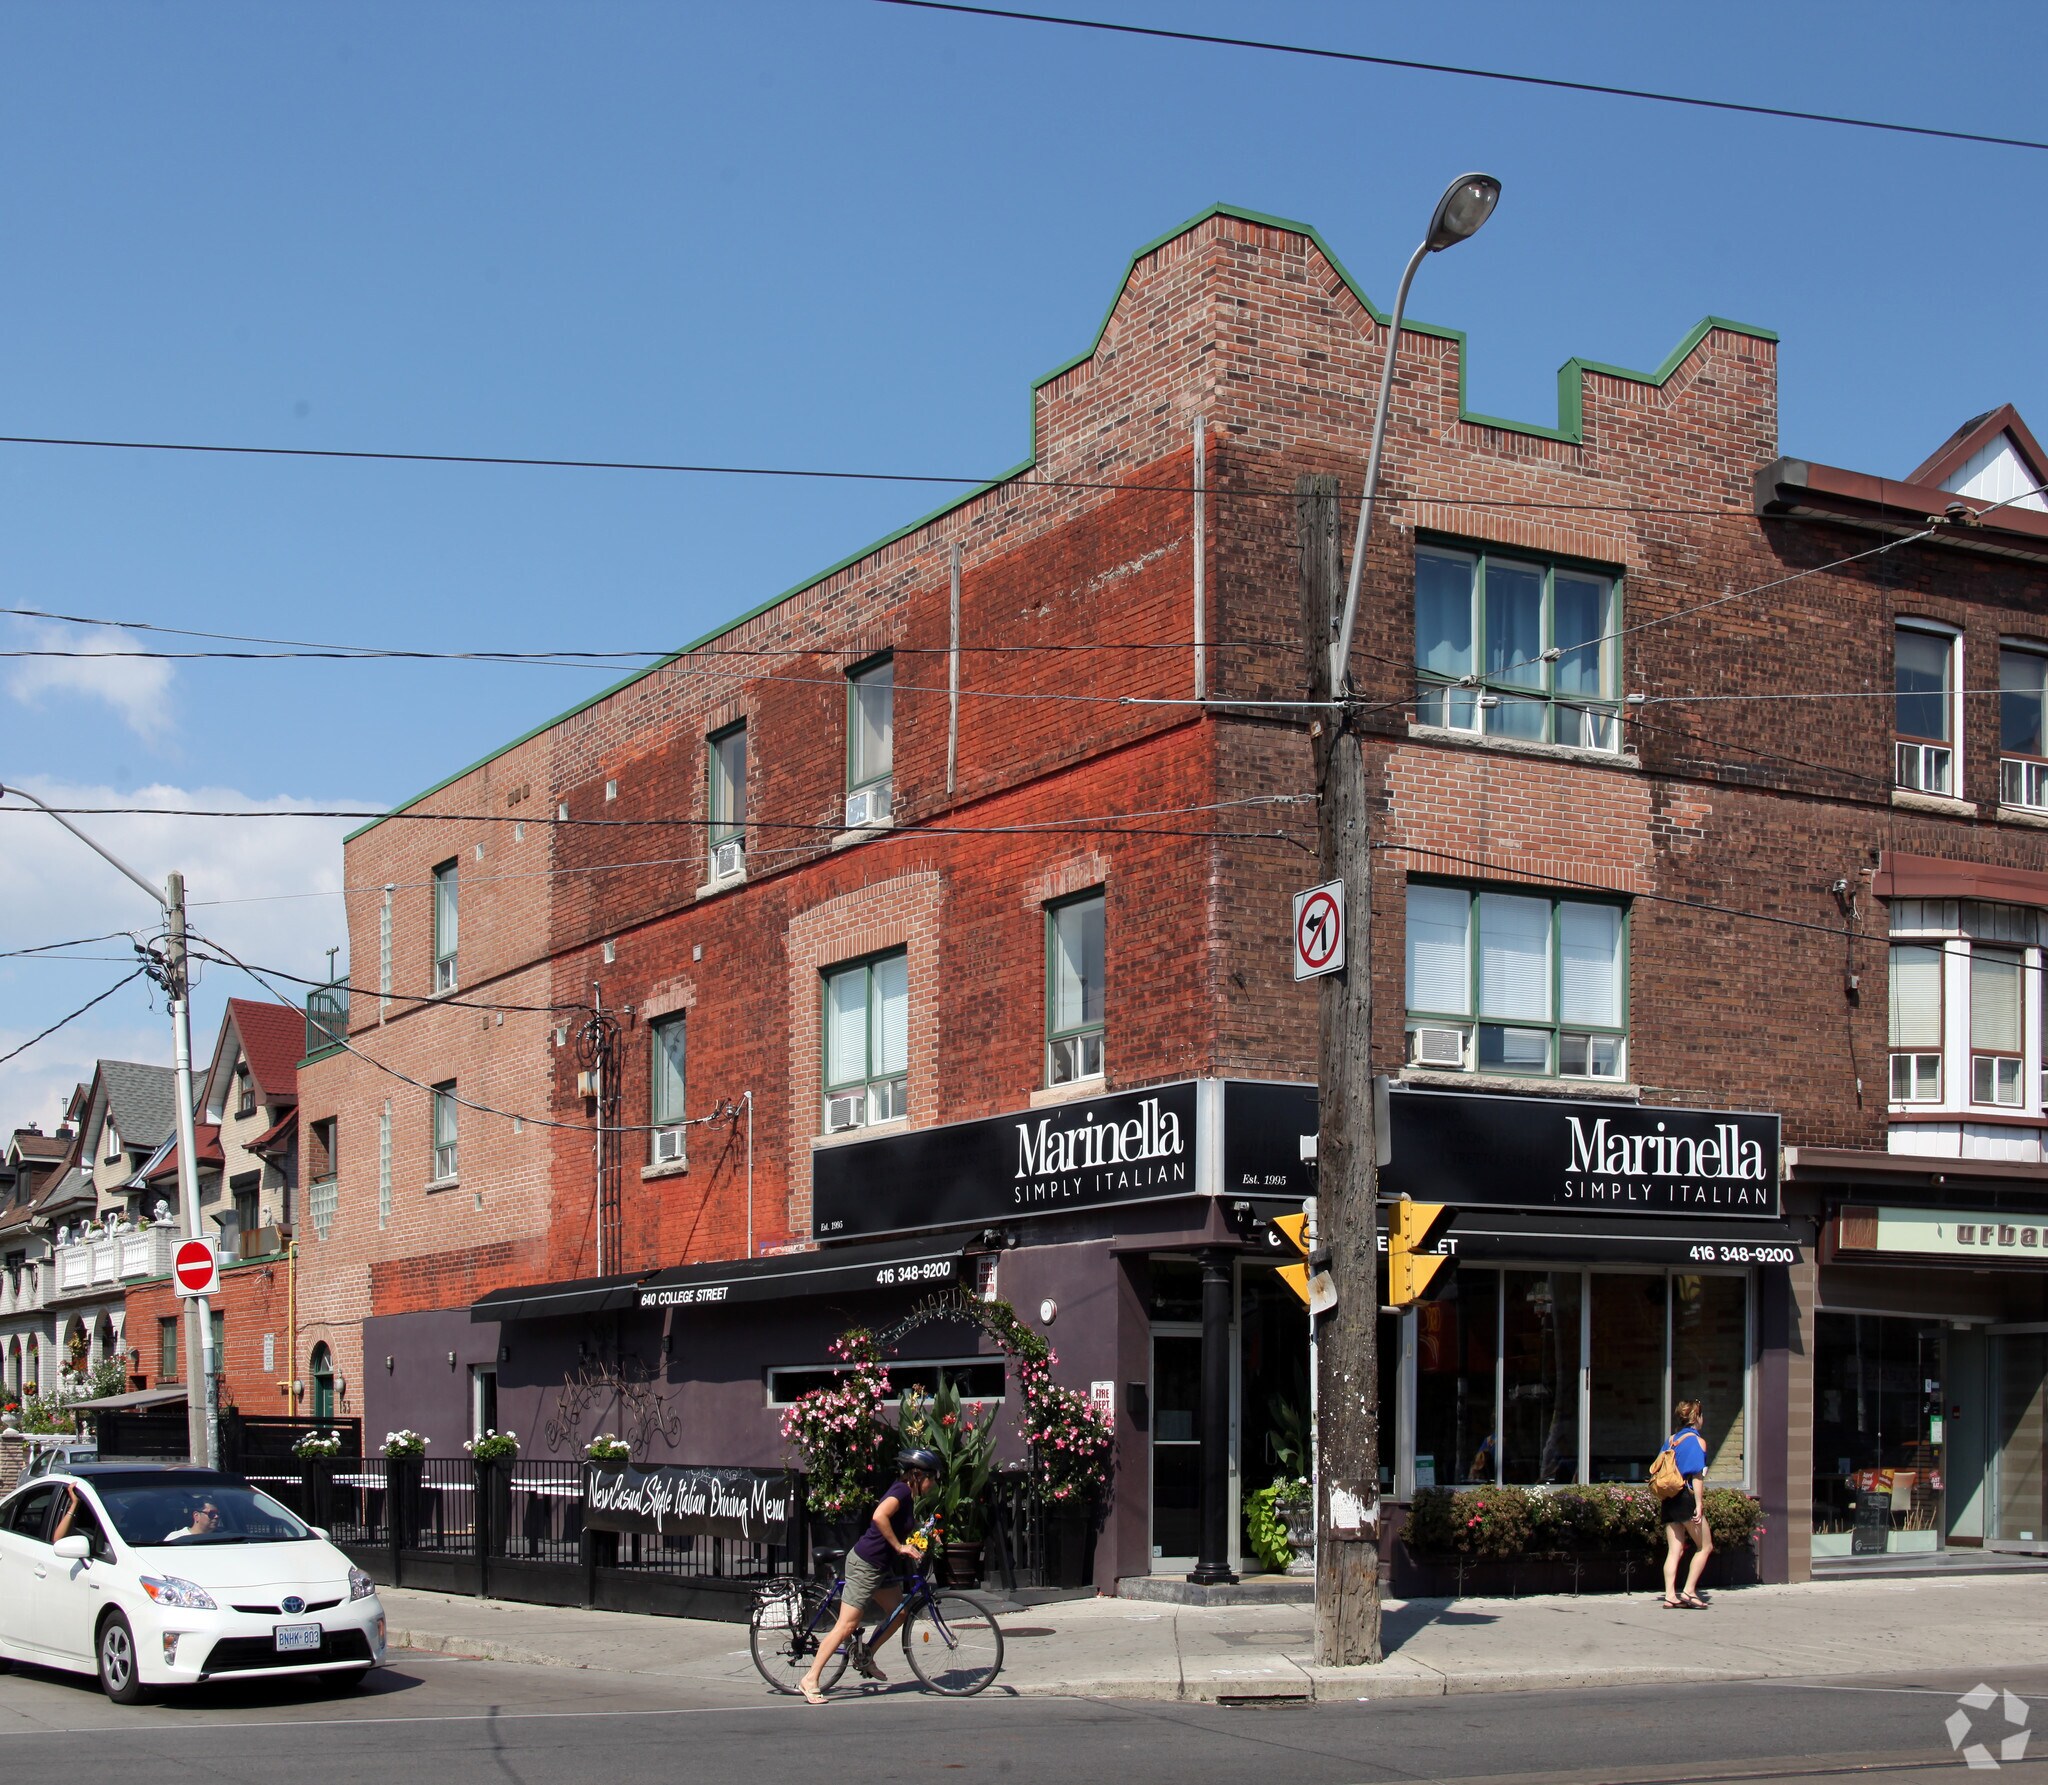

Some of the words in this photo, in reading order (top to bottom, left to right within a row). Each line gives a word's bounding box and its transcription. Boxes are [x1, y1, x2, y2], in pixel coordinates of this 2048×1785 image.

[1015, 1097, 1184, 1179] Marinella
[1565, 1116, 1767, 1180] Marinella
[1014, 1177, 1082, 1204] SIMPLY
[1096, 1162, 1185, 1192] ITALIAN
[1242, 1173, 1260, 1185] Est.
[1264, 1174, 1287, 1186] 1995
[1564, 1180, 1652, 1201] SIMPLY
[1669, 1184, 1767, 1204] ITALIAN
[1957, 1223, 2048, 1248] urba
[1689, 1245, 1716, 1261] 416
[1720, 1246, 1794, 1263] 348-9200
[876, 1268, 895, 1284] 416
[898, 1261, 951, 1282] 348-9200
[641, 1293, 657, 1306] 640
[658, 1290, 695, 1305] COLLEGE
[696, 1286, 729, 1302] STREET
[1095, 1388, 1110, 1399] FIRE
[641, 1475, 672, 1533] Style
[674, 1478, 705, 1519] Italian
[709, 1478, 749, 1539] Dining
[750, 1480, 785, 1524] Menu
[304, 1630, 319, 1644] 803
